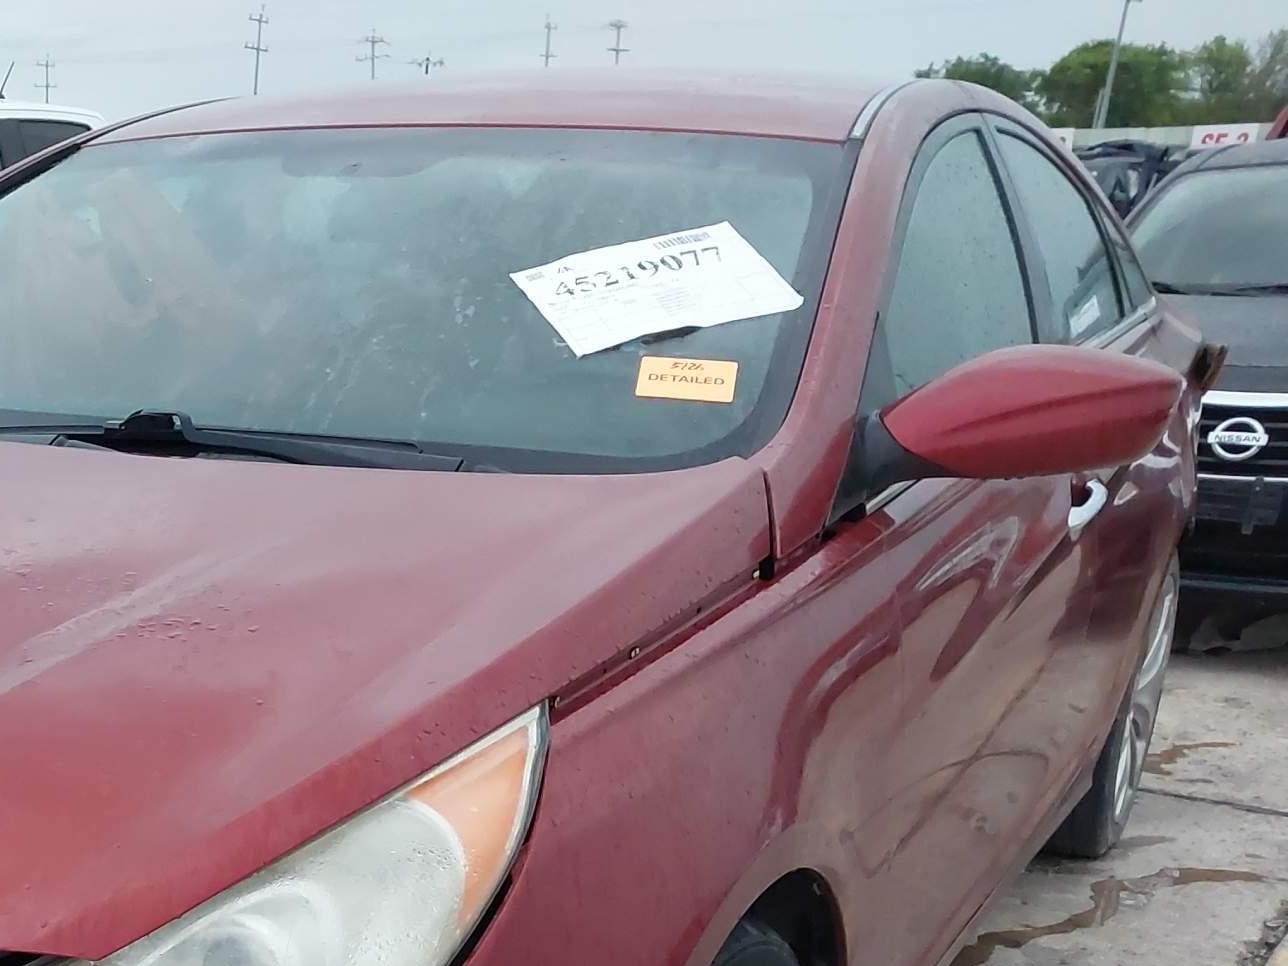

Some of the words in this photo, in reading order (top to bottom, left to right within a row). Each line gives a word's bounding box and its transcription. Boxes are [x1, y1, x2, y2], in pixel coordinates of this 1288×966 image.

[555, 246, 722, 297] 45219077
[648, 373, 725, 386] DETAILED
[1214, 434, 1262, 443] NISSAN
